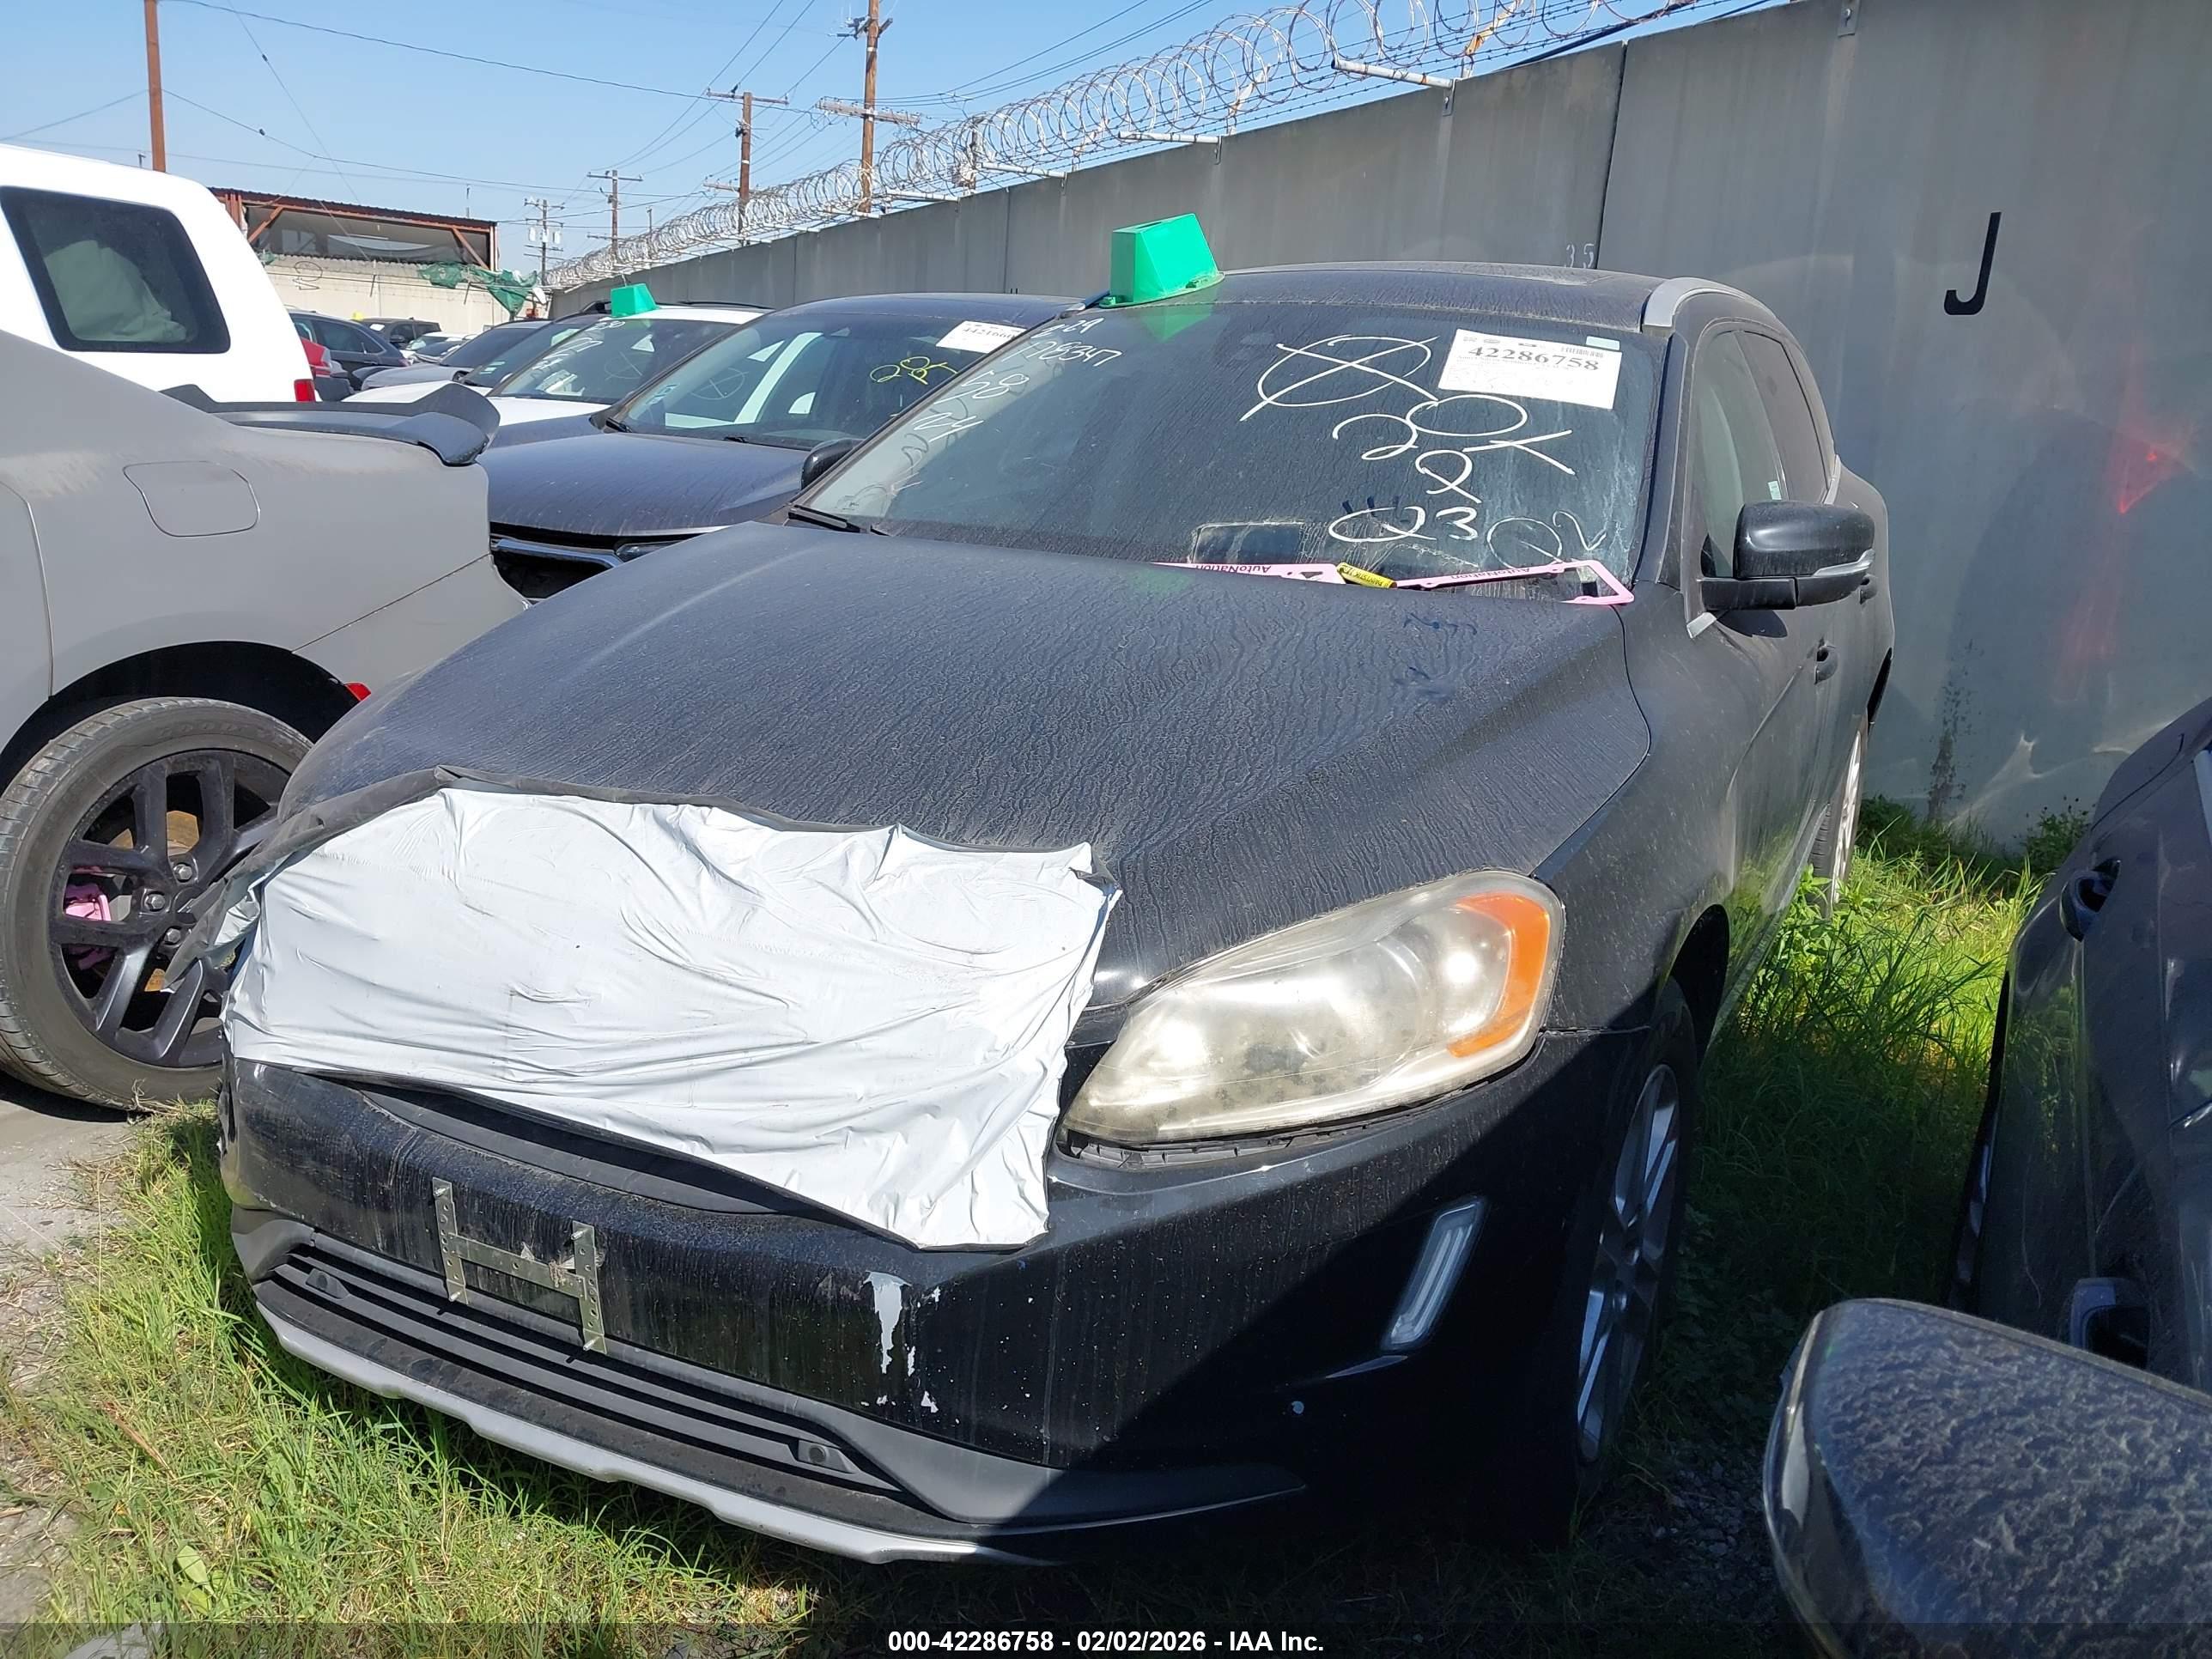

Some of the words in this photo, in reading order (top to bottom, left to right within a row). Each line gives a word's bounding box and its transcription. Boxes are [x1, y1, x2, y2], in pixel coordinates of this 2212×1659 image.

[1943, 211, 2002, 316] J
[1468, 346, 1600, 371] 42286758
[1195, 564, 1272, 574] AutoNation
[1449, 568, 1530, 580] AutoNation
